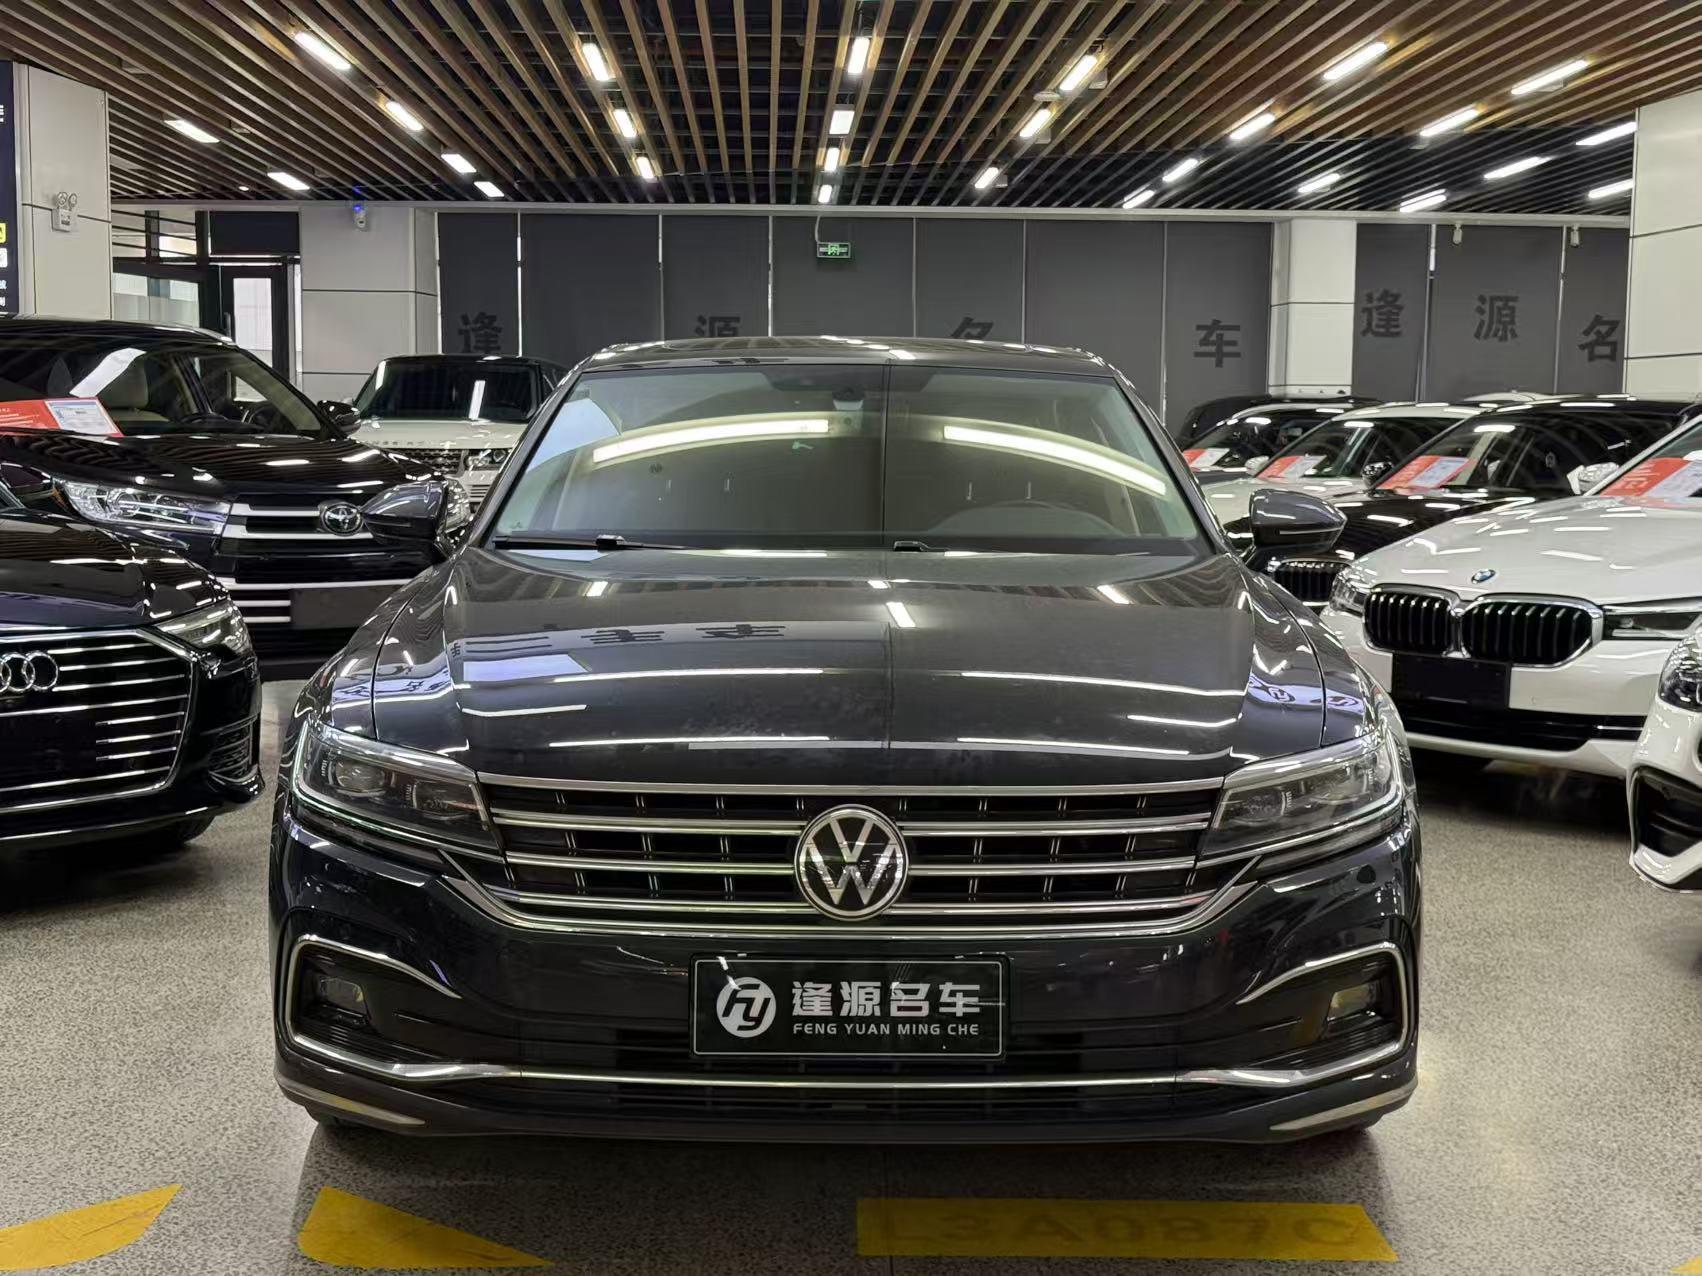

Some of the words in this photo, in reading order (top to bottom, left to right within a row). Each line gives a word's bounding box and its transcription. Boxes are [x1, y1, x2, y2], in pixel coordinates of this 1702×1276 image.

[1193, 317, 1242, 369] 车
[1361, 289, 1405, 339] 逢
[1473, 293, 1520, 343] 源
[1577, 314, 1621, 363] 名
[792, 981, 981, 1017] 逢源名车
[792, 1022, 838, 1036] FENG
[844, 1022, 891, 1036] YUAN
[896, 1022, 941, 1036] MING
[947, 1022, 980, 1036] CHE
